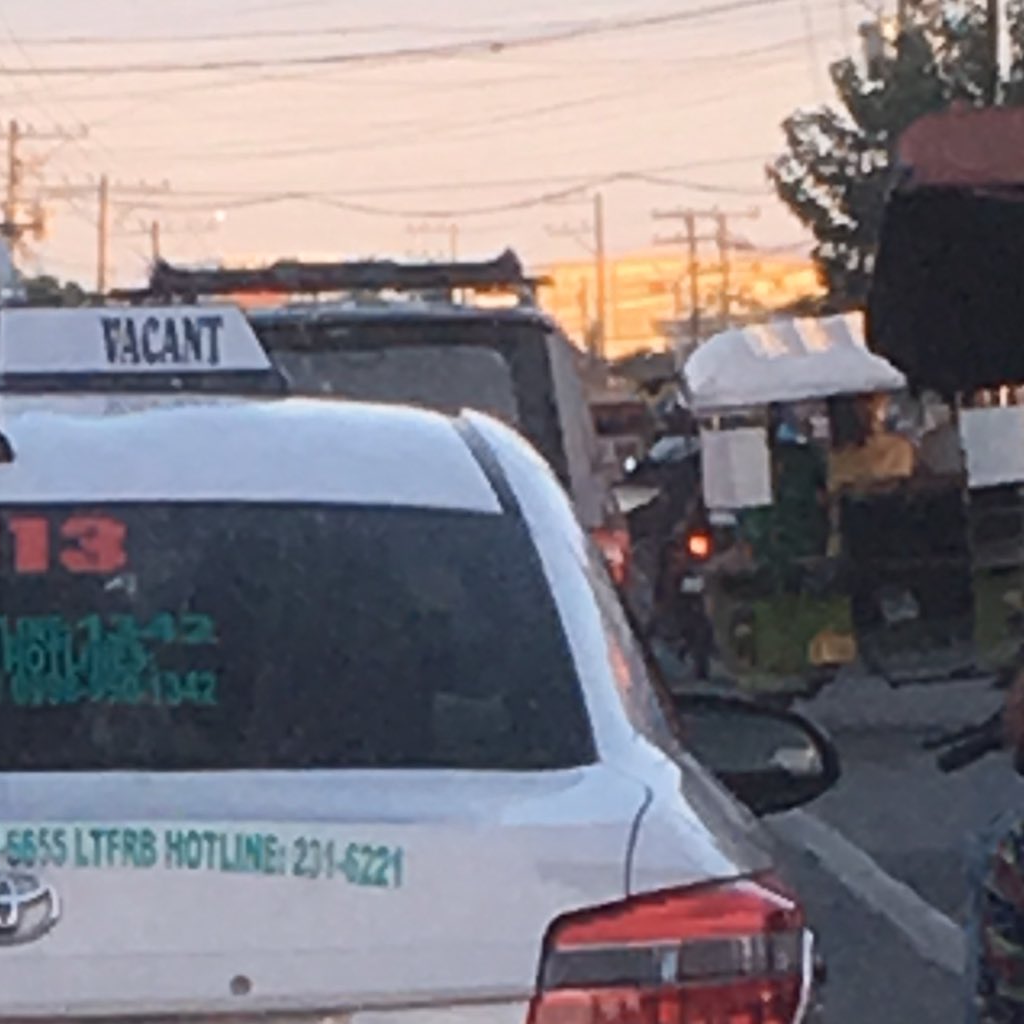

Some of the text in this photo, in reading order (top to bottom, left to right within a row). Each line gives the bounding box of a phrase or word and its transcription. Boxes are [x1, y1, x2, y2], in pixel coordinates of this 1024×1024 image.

[100, 315, 224, 366] VACANT
[74, 827, 158, 869] LTFRB
[164, 829, 285, 876] HOTLINE:
